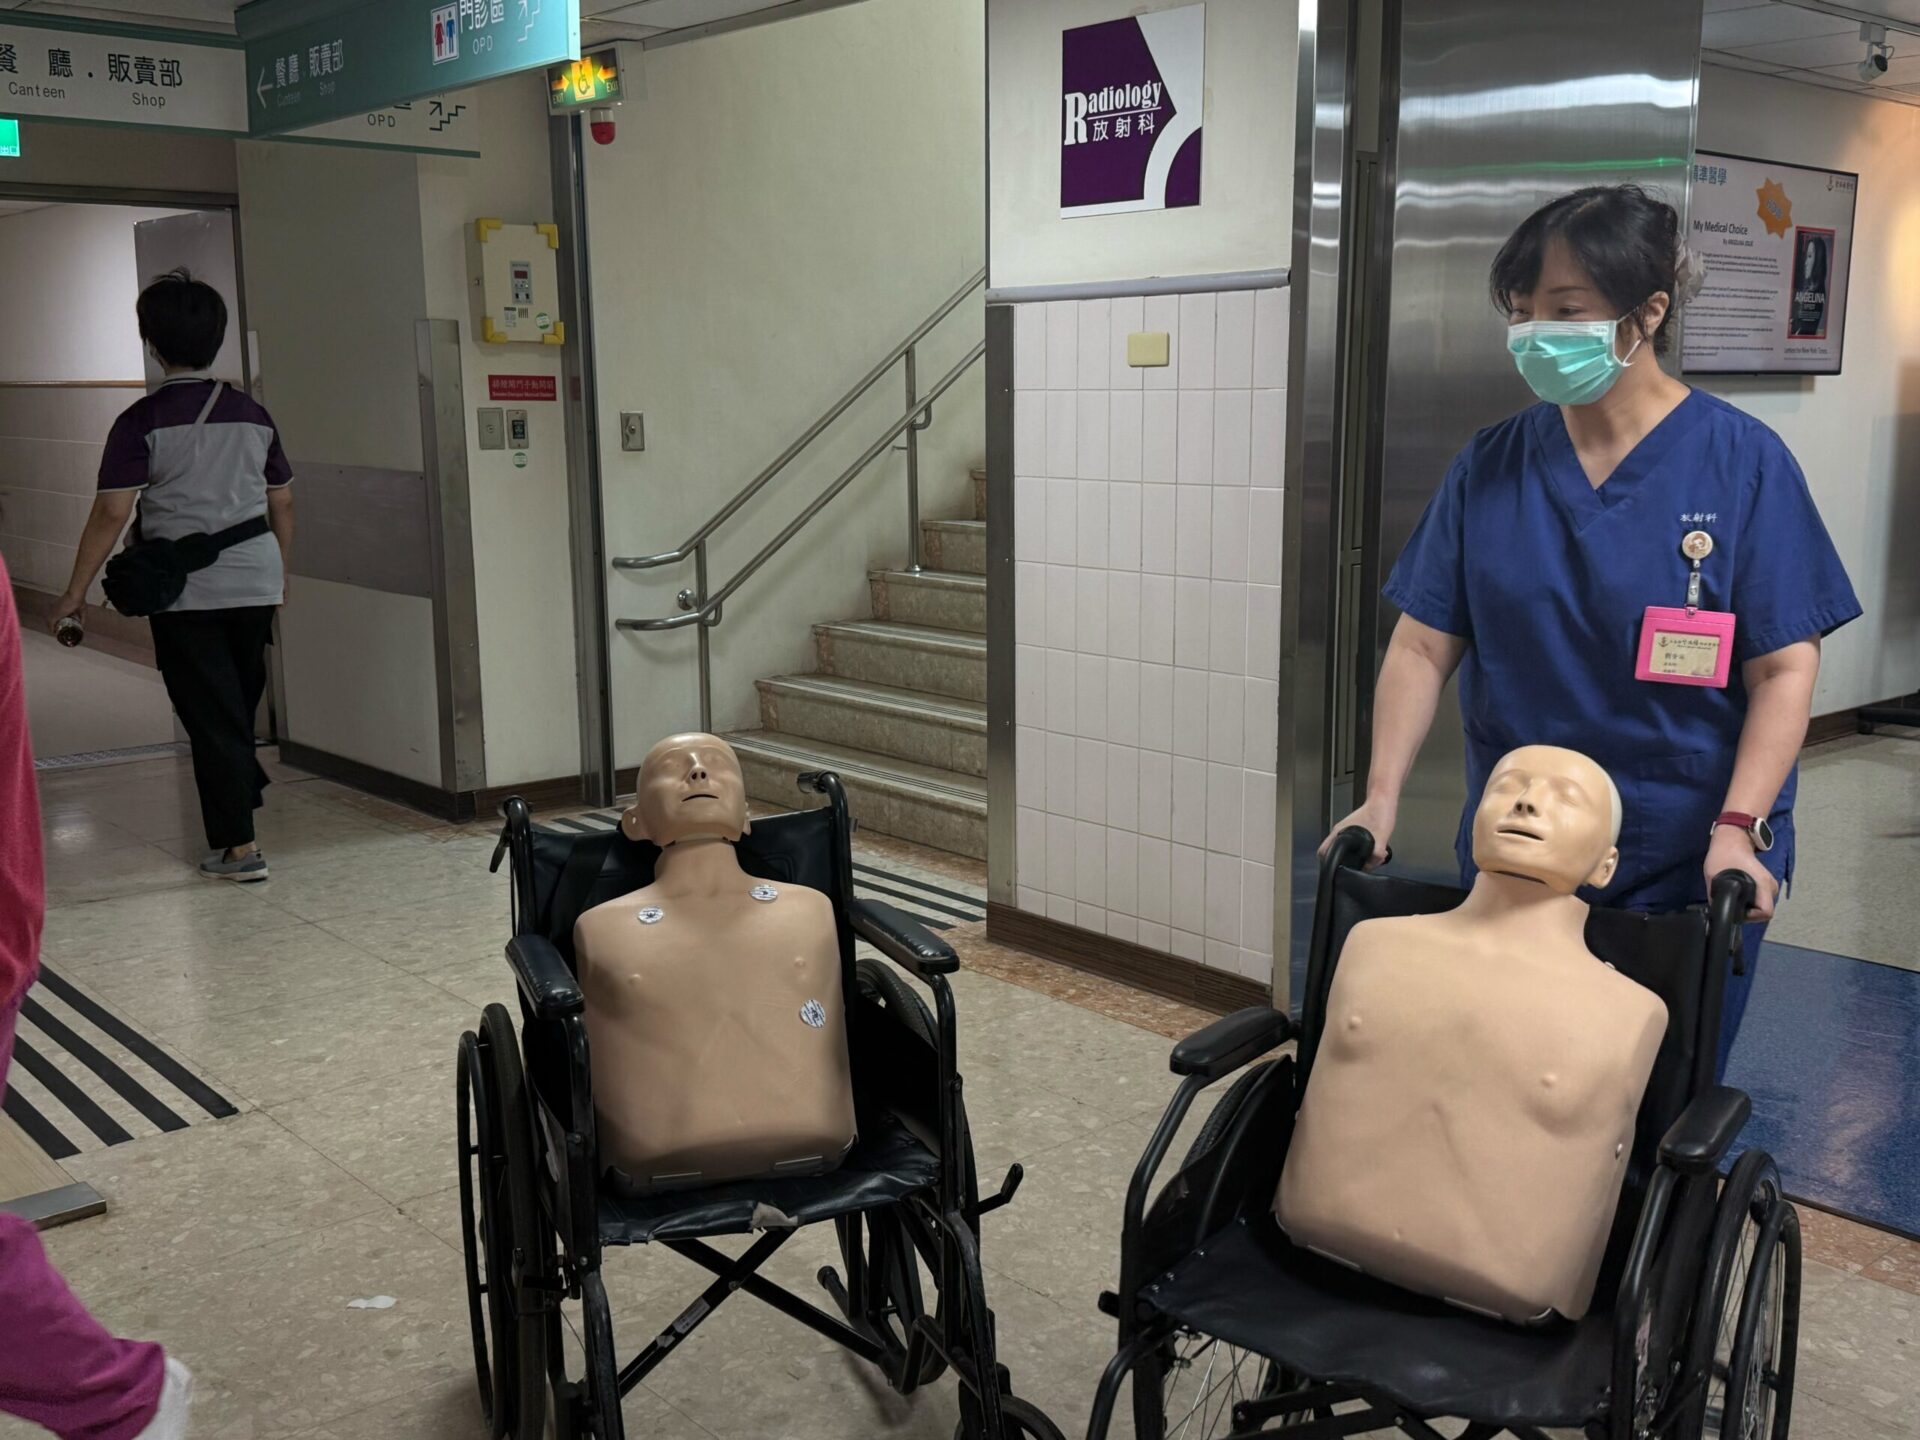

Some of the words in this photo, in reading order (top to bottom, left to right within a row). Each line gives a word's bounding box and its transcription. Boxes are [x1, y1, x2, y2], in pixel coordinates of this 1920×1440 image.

[308, 39, 345, 78] 販賣部
[472, 35, 494, 55] OPD
[107, 53, 183, 88] 販賣部
[8, 81, 66, 99] Canteen
[132, 92, 166, 108] Shop
[366, 113, 396, 128] OPD
[1064, 80, 1162, 146] Radiology
[1093, 113, 1155, 142] 放射科
[1693, 220, 1703, 233] My
[1704, 221, 1728, 233] Medical
[1729, 223, 1748, 236] Choice
[1795, 291, 1826, 306] ANGELINA
